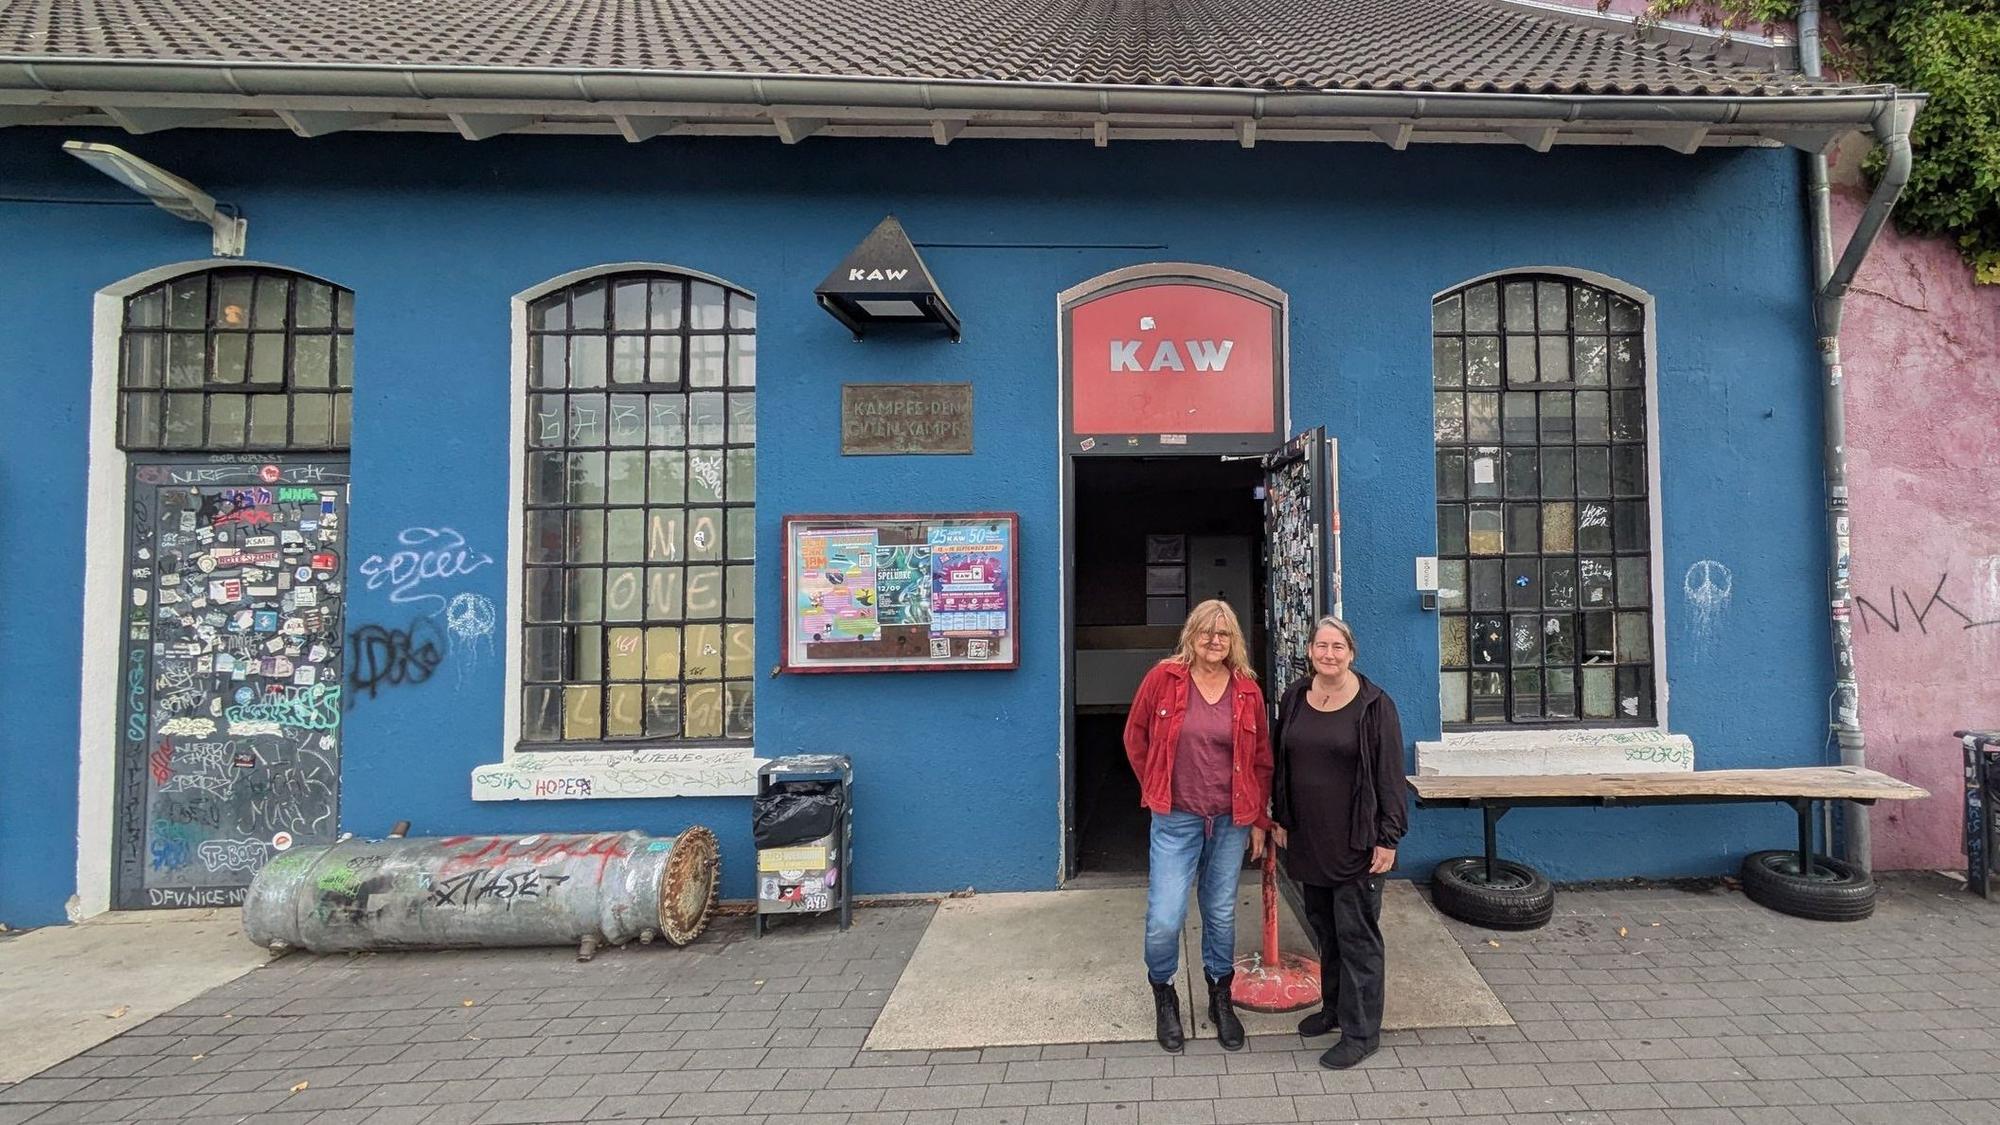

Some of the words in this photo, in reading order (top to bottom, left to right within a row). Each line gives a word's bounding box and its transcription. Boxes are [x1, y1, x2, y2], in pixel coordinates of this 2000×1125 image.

[849, 268, 908, 280] KAW
[1109, 340, 1234, 372] KAW
[650, 516, 715, 558] NO
[931, 529, 947, 544] 25
[968, 528, 986, 543] 50
[609, 571, 720, 613] ONE
